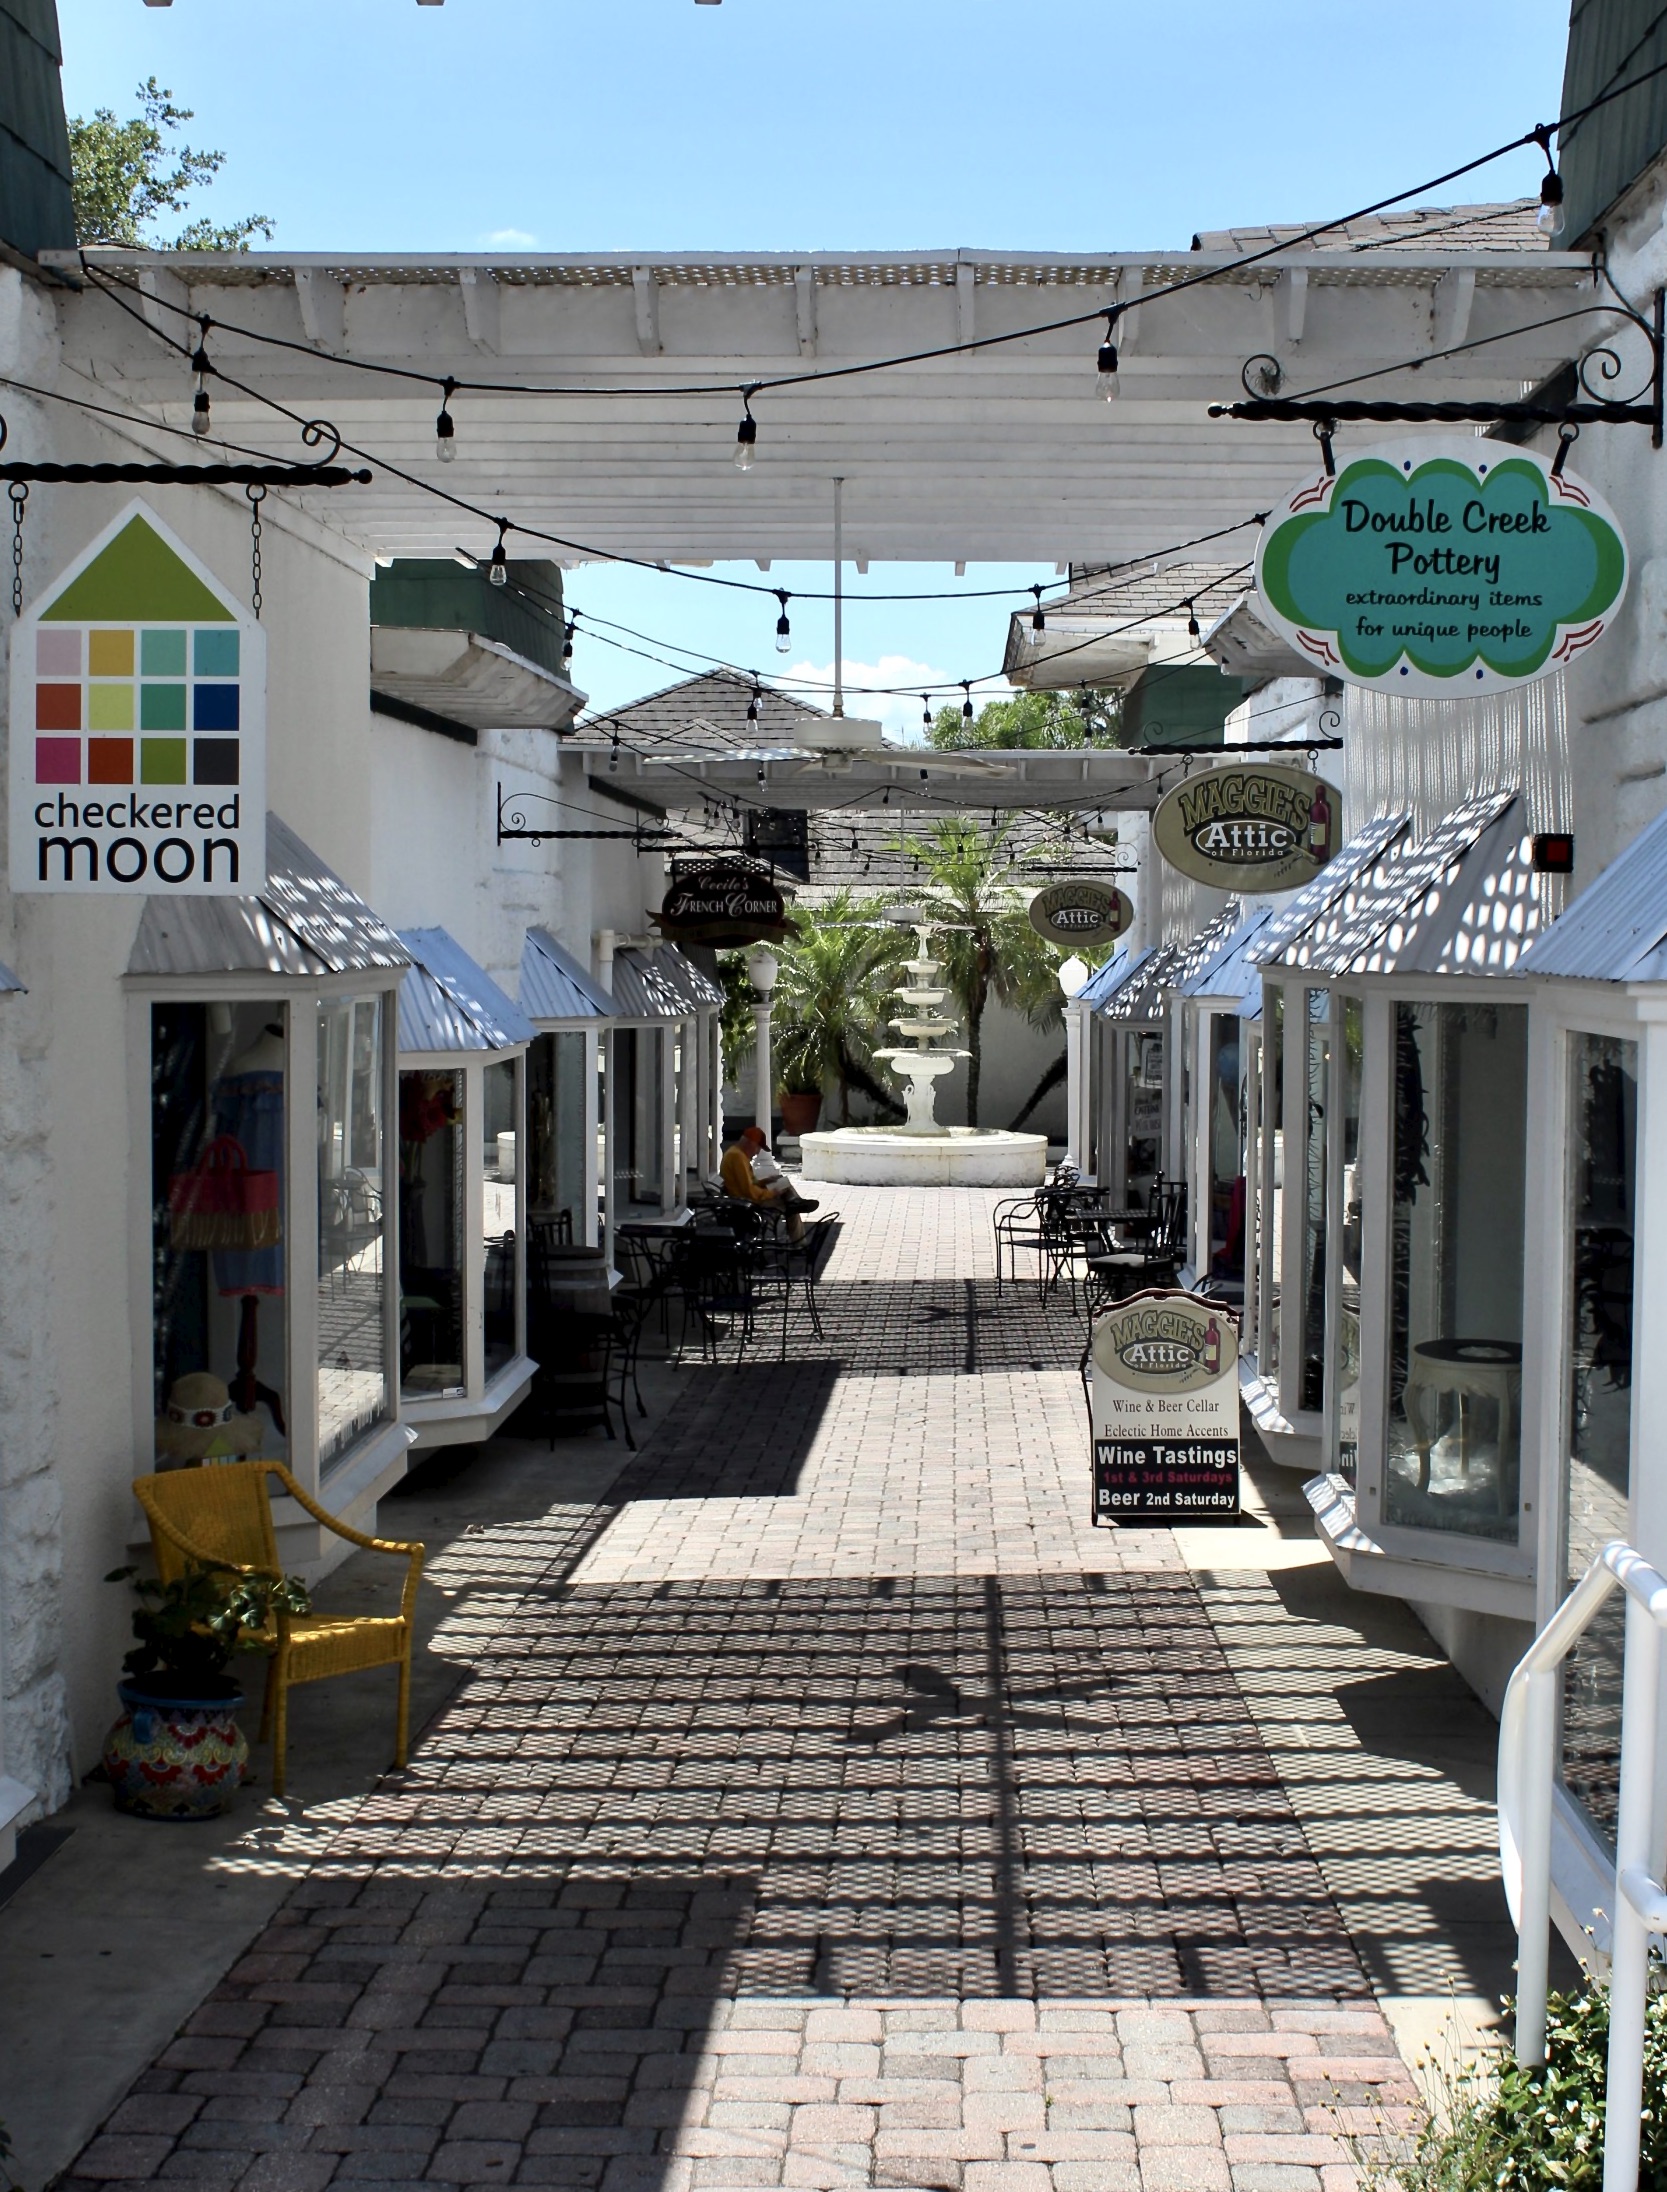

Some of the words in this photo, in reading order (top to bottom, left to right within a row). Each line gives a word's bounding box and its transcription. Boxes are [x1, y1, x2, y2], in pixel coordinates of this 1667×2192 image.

[1341, 498, 1453, 533] Double
[1463, 500, 1551, 533] Creek
[1384, 542, 1501, 584] Pottery
[1346, 587, 1480, 611] extraordinary
[1489, 589, 1543, 606] items
[1356, 616, 1384, 637] for
[1392, 622, 1460, 642] unique
[1467, 619, 1532, 642] people
[34, 792, 240, 829] checkered
[1178, 774, 1313, 835] MAGGIE'S
[1204, 822, 1288, 848] Attic
[38, 836, 240, 883] moon
[1232, 848, 1284, 856] Florida
[698, 876, 749, 891] Cecile's
[670, 892, 724, 916] FRENCH
[725, 892, 777, 917] CORNER
[1056, 911, 1099, 923] Attic
[1110, 1310, 1207, 1354] MAGGIE'S
[1129, 1343, 1189, 1363] Attic
[1113, 1400, 1142, 1413] Wine
[1145, 1400, 1155, 1413] &
[1158, 1400, 1182, 1412] Beer
[1187, 1399, 1220, 1412] Cellar
[1105, 1424, 1147, 1437] Eclectic
[1150, 1424, 1182, 1437] Home
[1186, 1424, 1229, 1437] Accents
[1098, 1446, 1146, 1464] Wine
[1153, 1446, 1237, 1469] Tastings
[1104, 1472, 1124, 1484] 1st
[1128, 1472, 1138, 1484] &
[1142, 1472, 1163, 1484] 3rd
[1167, 1471, 1233, 1486] Saturdays
[1099, 1489, 1140, 1506] Beer
[1146, 1492, 1170, 1506] 2nd
[1174, 1492, 1235, 1508] Saturday
